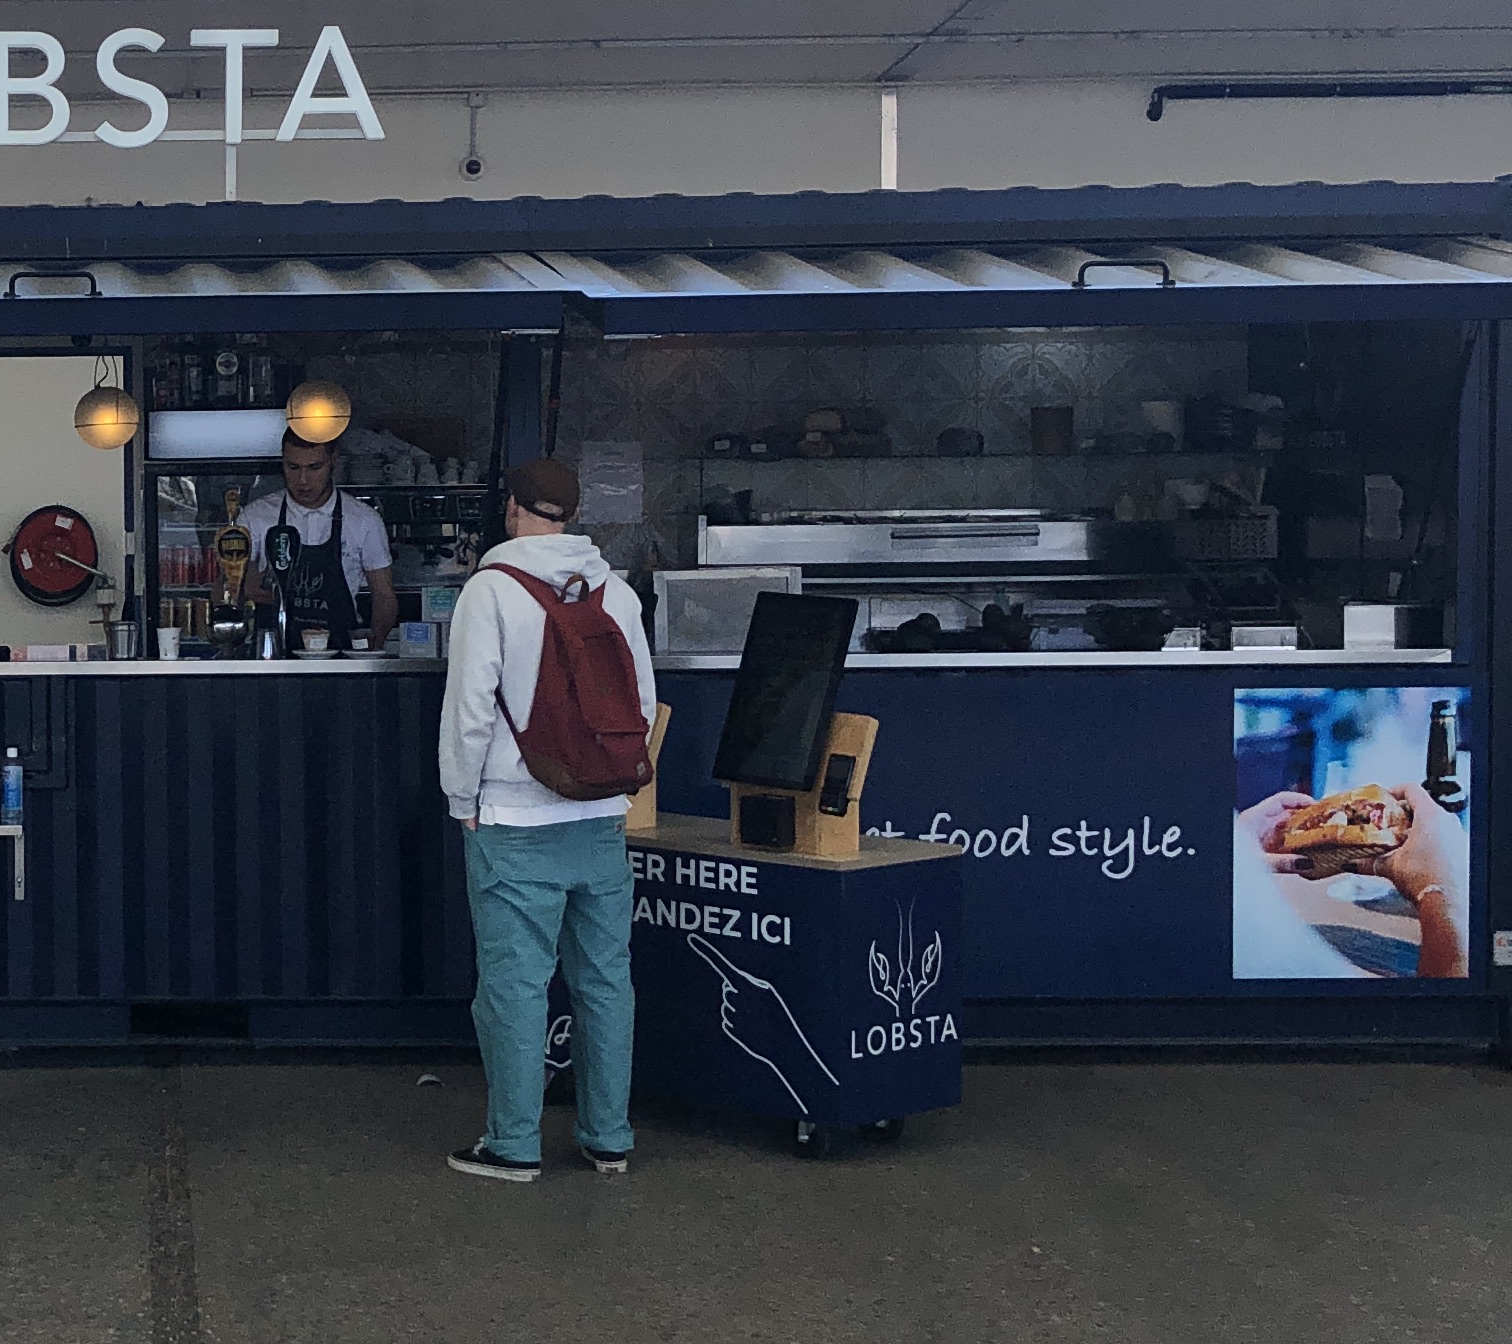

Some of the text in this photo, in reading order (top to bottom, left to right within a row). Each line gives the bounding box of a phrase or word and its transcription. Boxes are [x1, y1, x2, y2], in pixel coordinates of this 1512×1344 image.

[294, 597, 328, 610] BSTA
[918, 812, 1197, 880] food style.
[675, 856, 759, 896] HERE
[632, 895, 792, 946] ANDEZ ICI
[851, 1012, 959, 1060] LOBSTA
